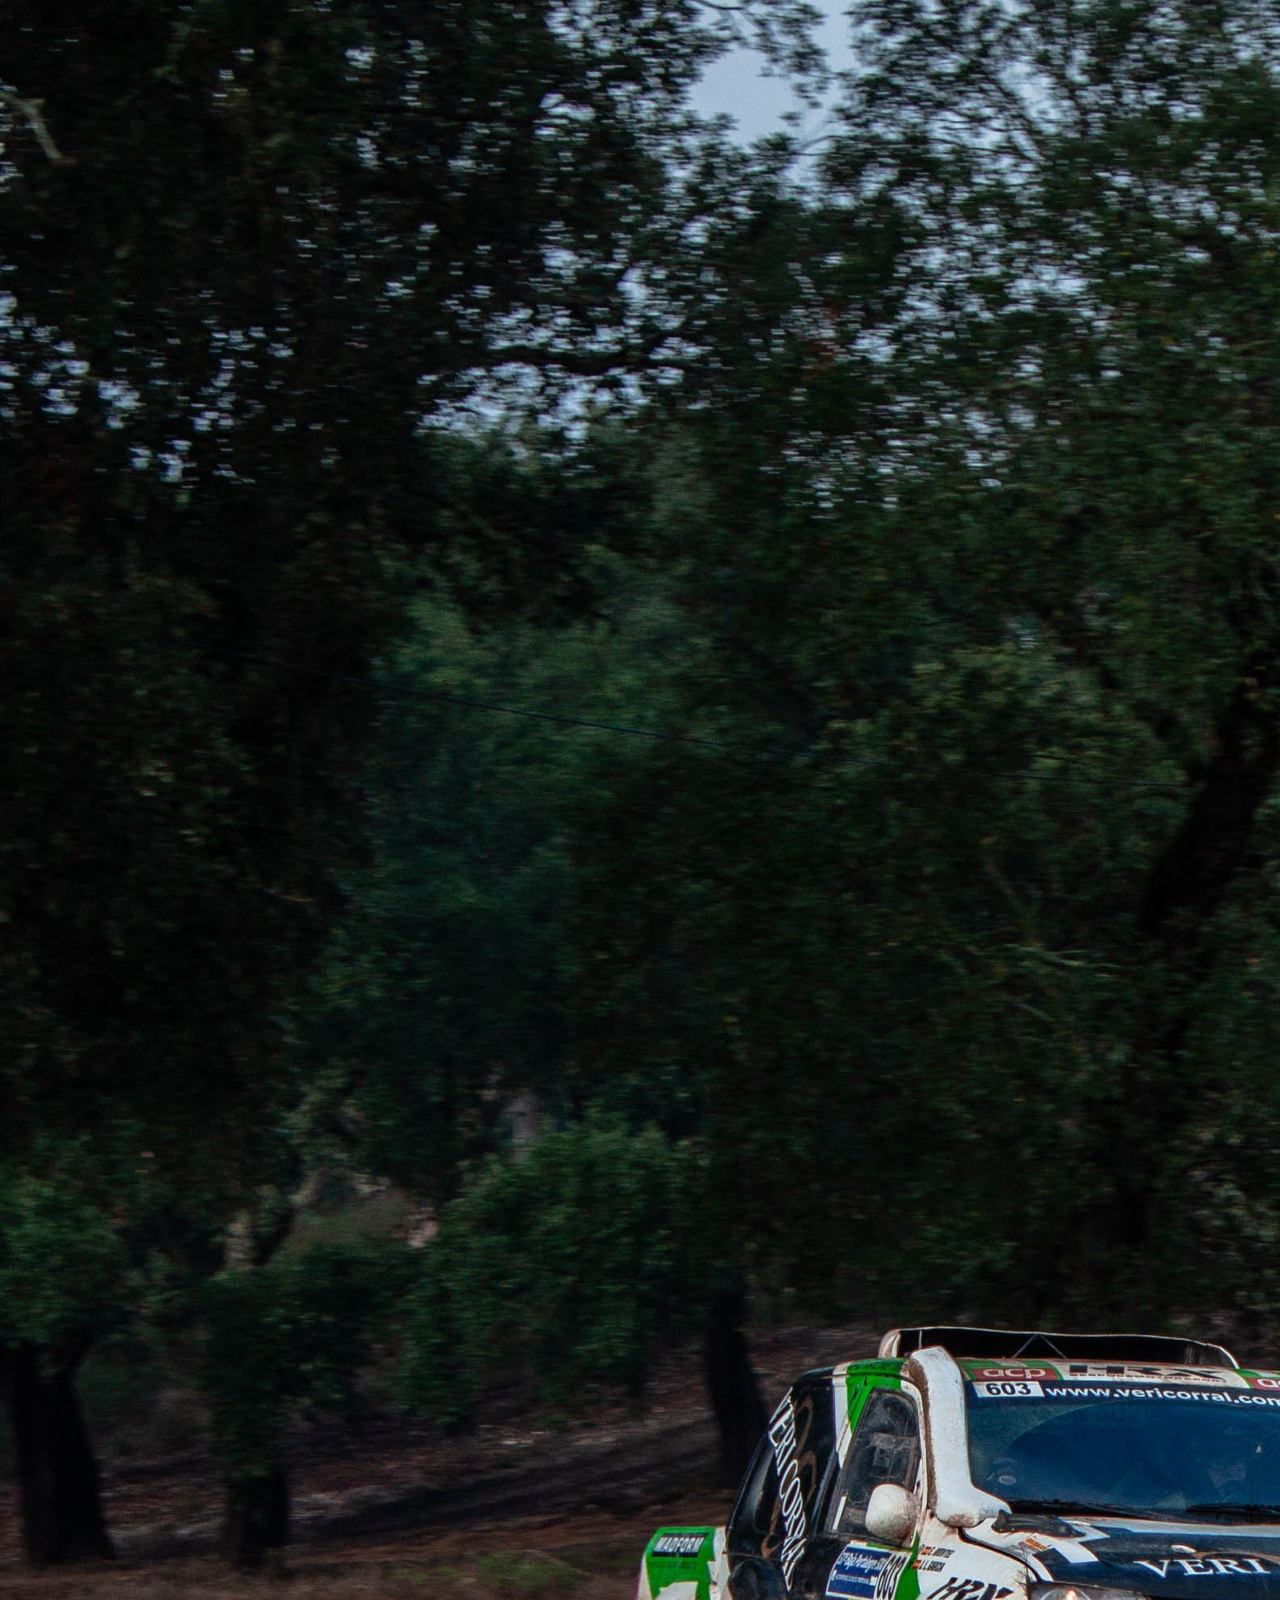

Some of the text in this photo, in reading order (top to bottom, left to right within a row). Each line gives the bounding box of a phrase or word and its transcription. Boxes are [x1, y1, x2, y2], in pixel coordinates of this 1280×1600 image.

[983, 1368, 1046, 1380] acp
[986, 1382, 1032, 1396] 603
[768, 1386, 808, 1592] VERI CORRAL
[653, 1536, 705, 1553] MADFORM
[876, 1554, 907, 1600] 603
[1133, 1558, 1271, 1579] VERI
